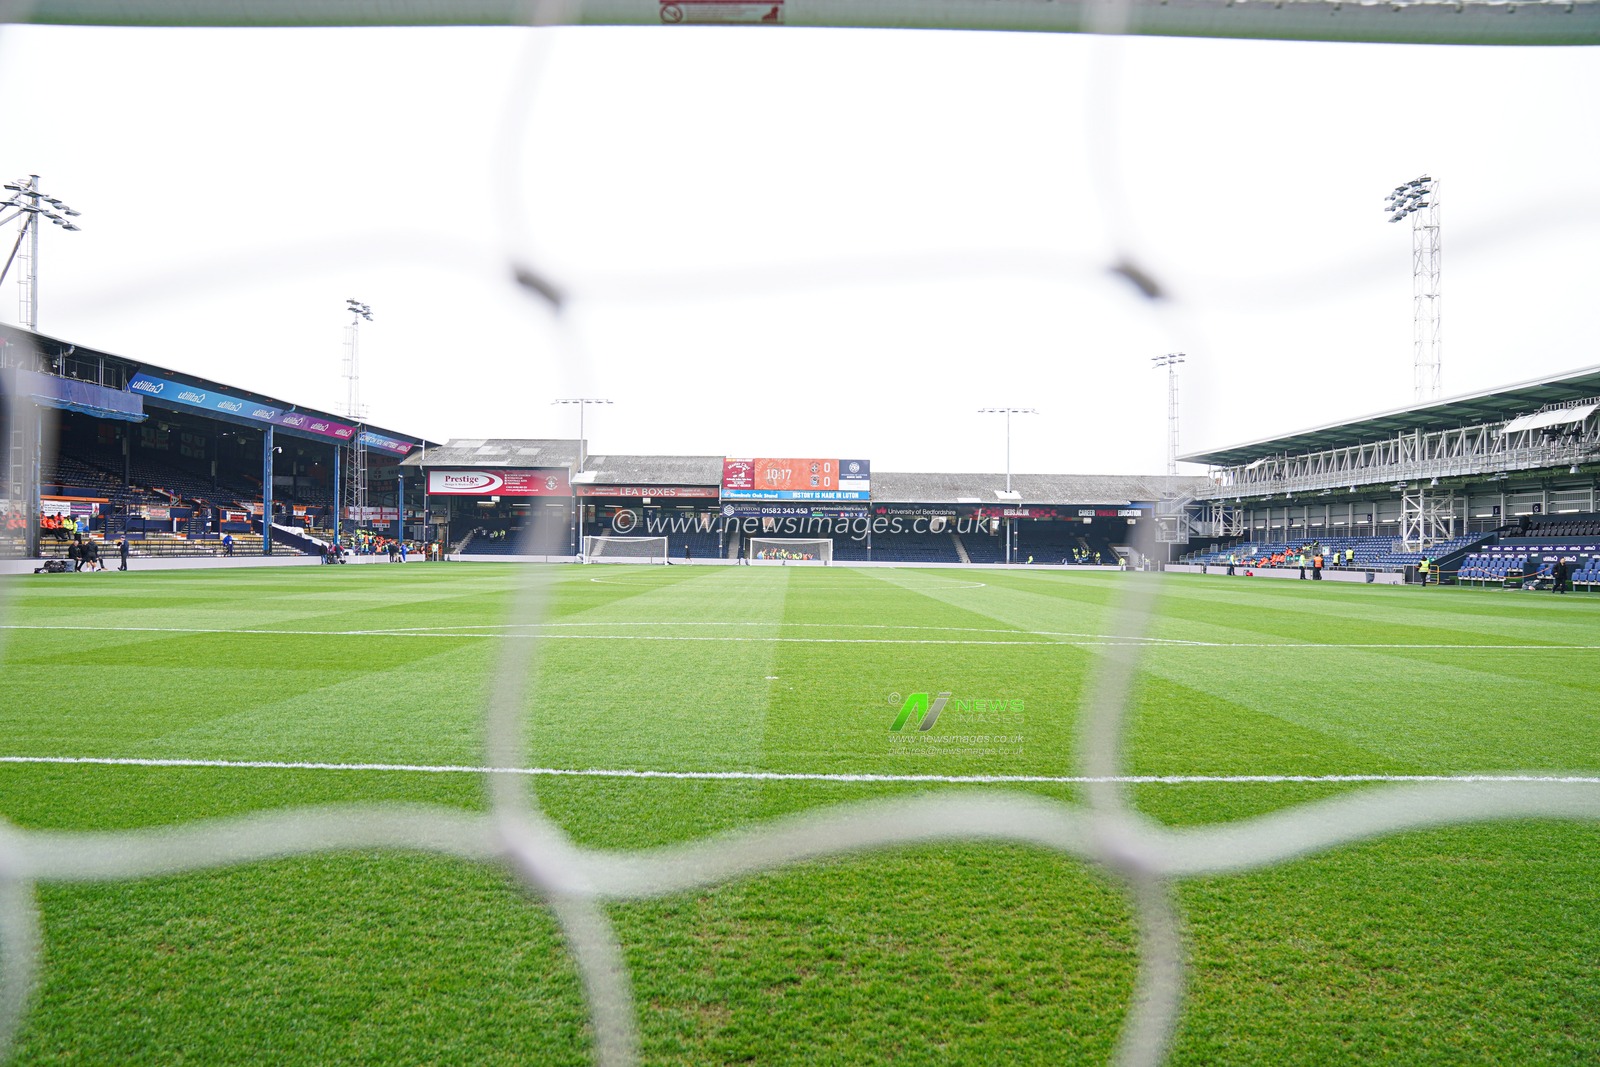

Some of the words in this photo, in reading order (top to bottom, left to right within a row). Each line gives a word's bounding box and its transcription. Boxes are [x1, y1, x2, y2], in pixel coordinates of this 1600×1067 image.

[132, 380, 157, 392] utilita
[178, 391, 199, 402] utilita
[217, 401, 236, 411] utilita
[823, 462, 831, 473] 0
[766, 468, 792, 480] 10:17
[445, 475, 479, 484] Prestige
[823, 476, 831, 487] 0
[620, 487, 639, 496] LEA
[641, 487, 676, 496] BOXES
[888, 508, 915, 516] University
[1003, 508, 1030, 516] BEDS.AC.UK
[1078, 509, 1095, 517] CAREER
[1117, 509, 1142, 517] EDUCATION
